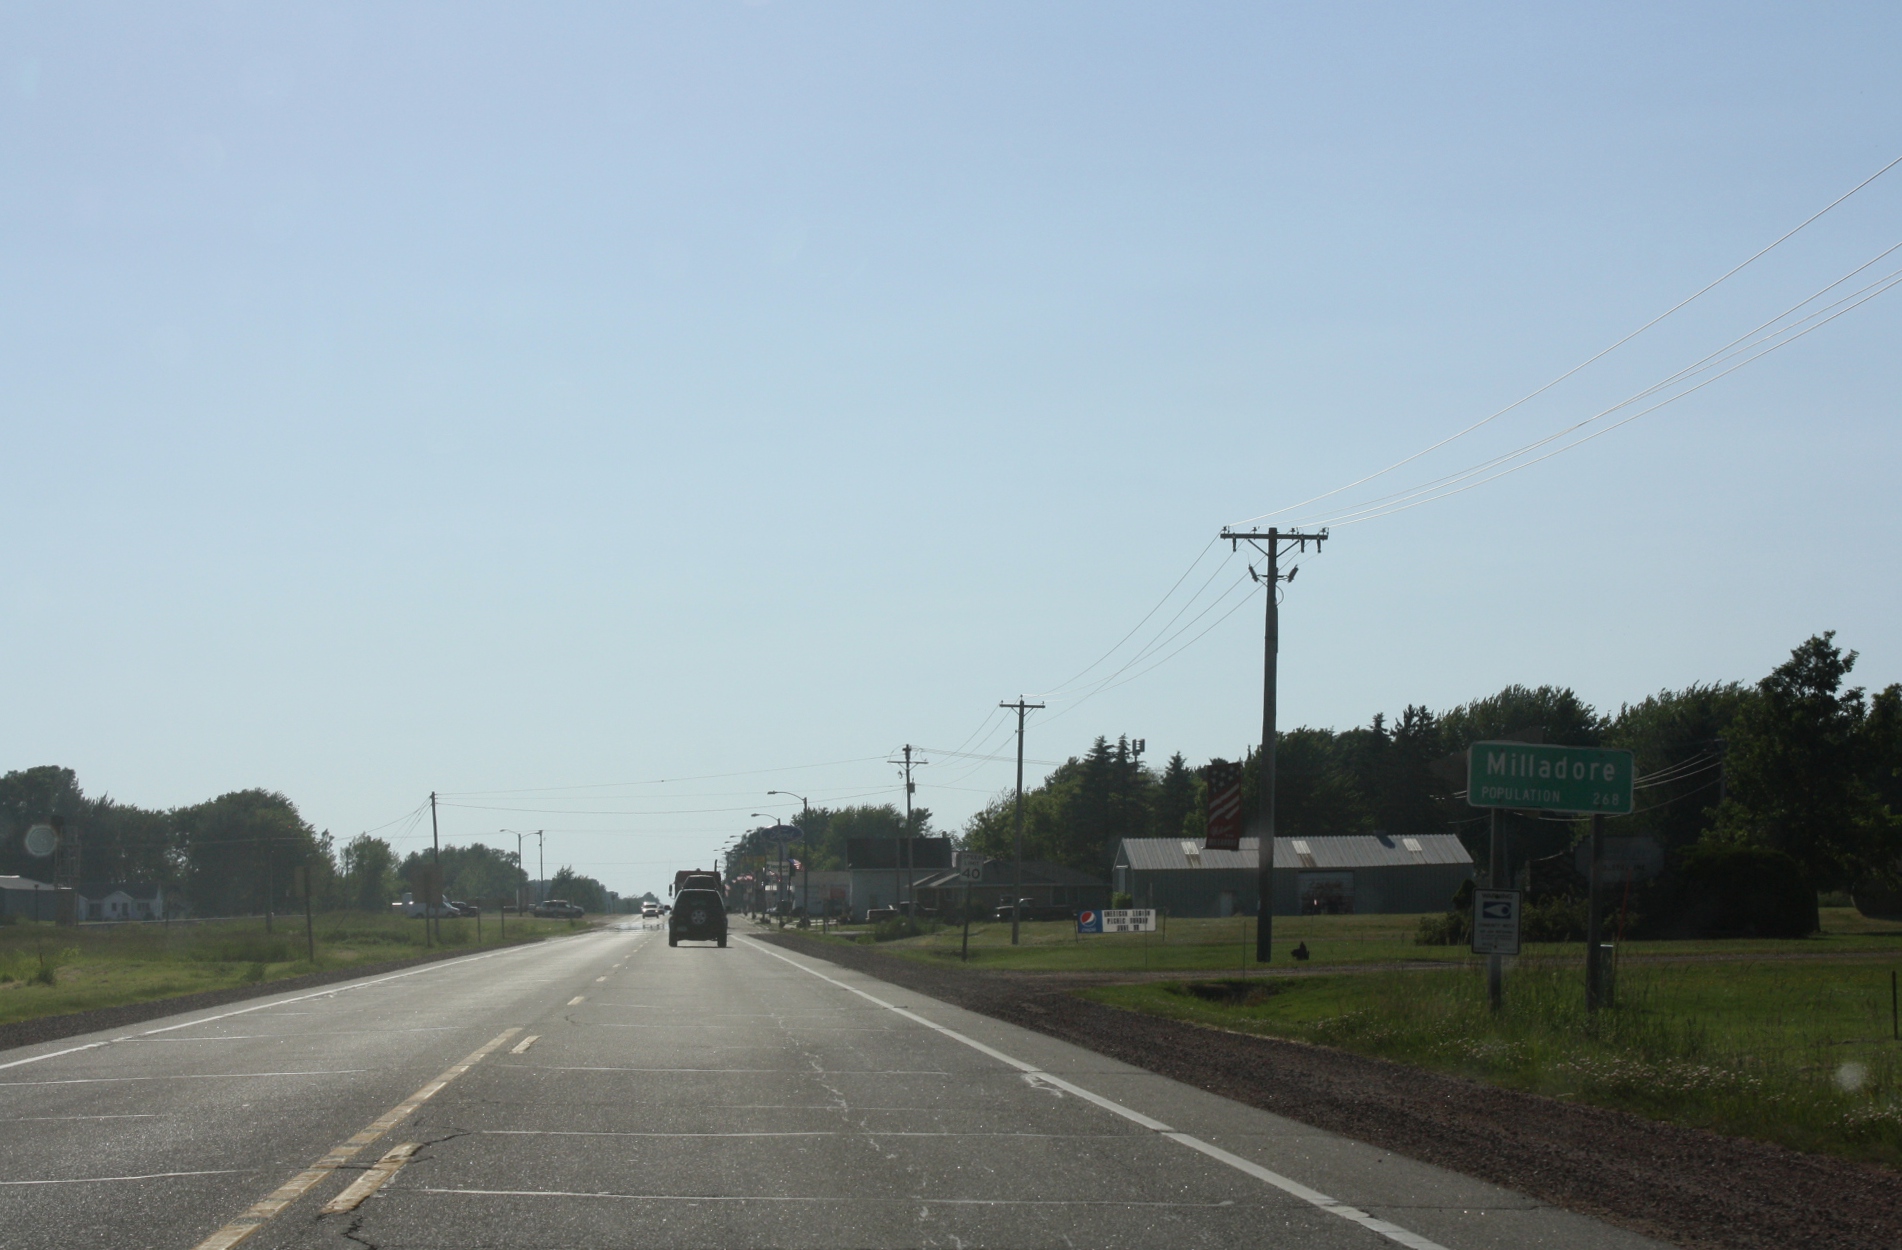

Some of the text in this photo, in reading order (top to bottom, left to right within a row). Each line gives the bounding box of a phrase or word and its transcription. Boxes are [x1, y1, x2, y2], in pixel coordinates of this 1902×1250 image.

[1487, 752, 1615, 781] Milladore
[1481, 786, 1620, 806] POPULATION 268
[961, 868, 980, 879] 40
